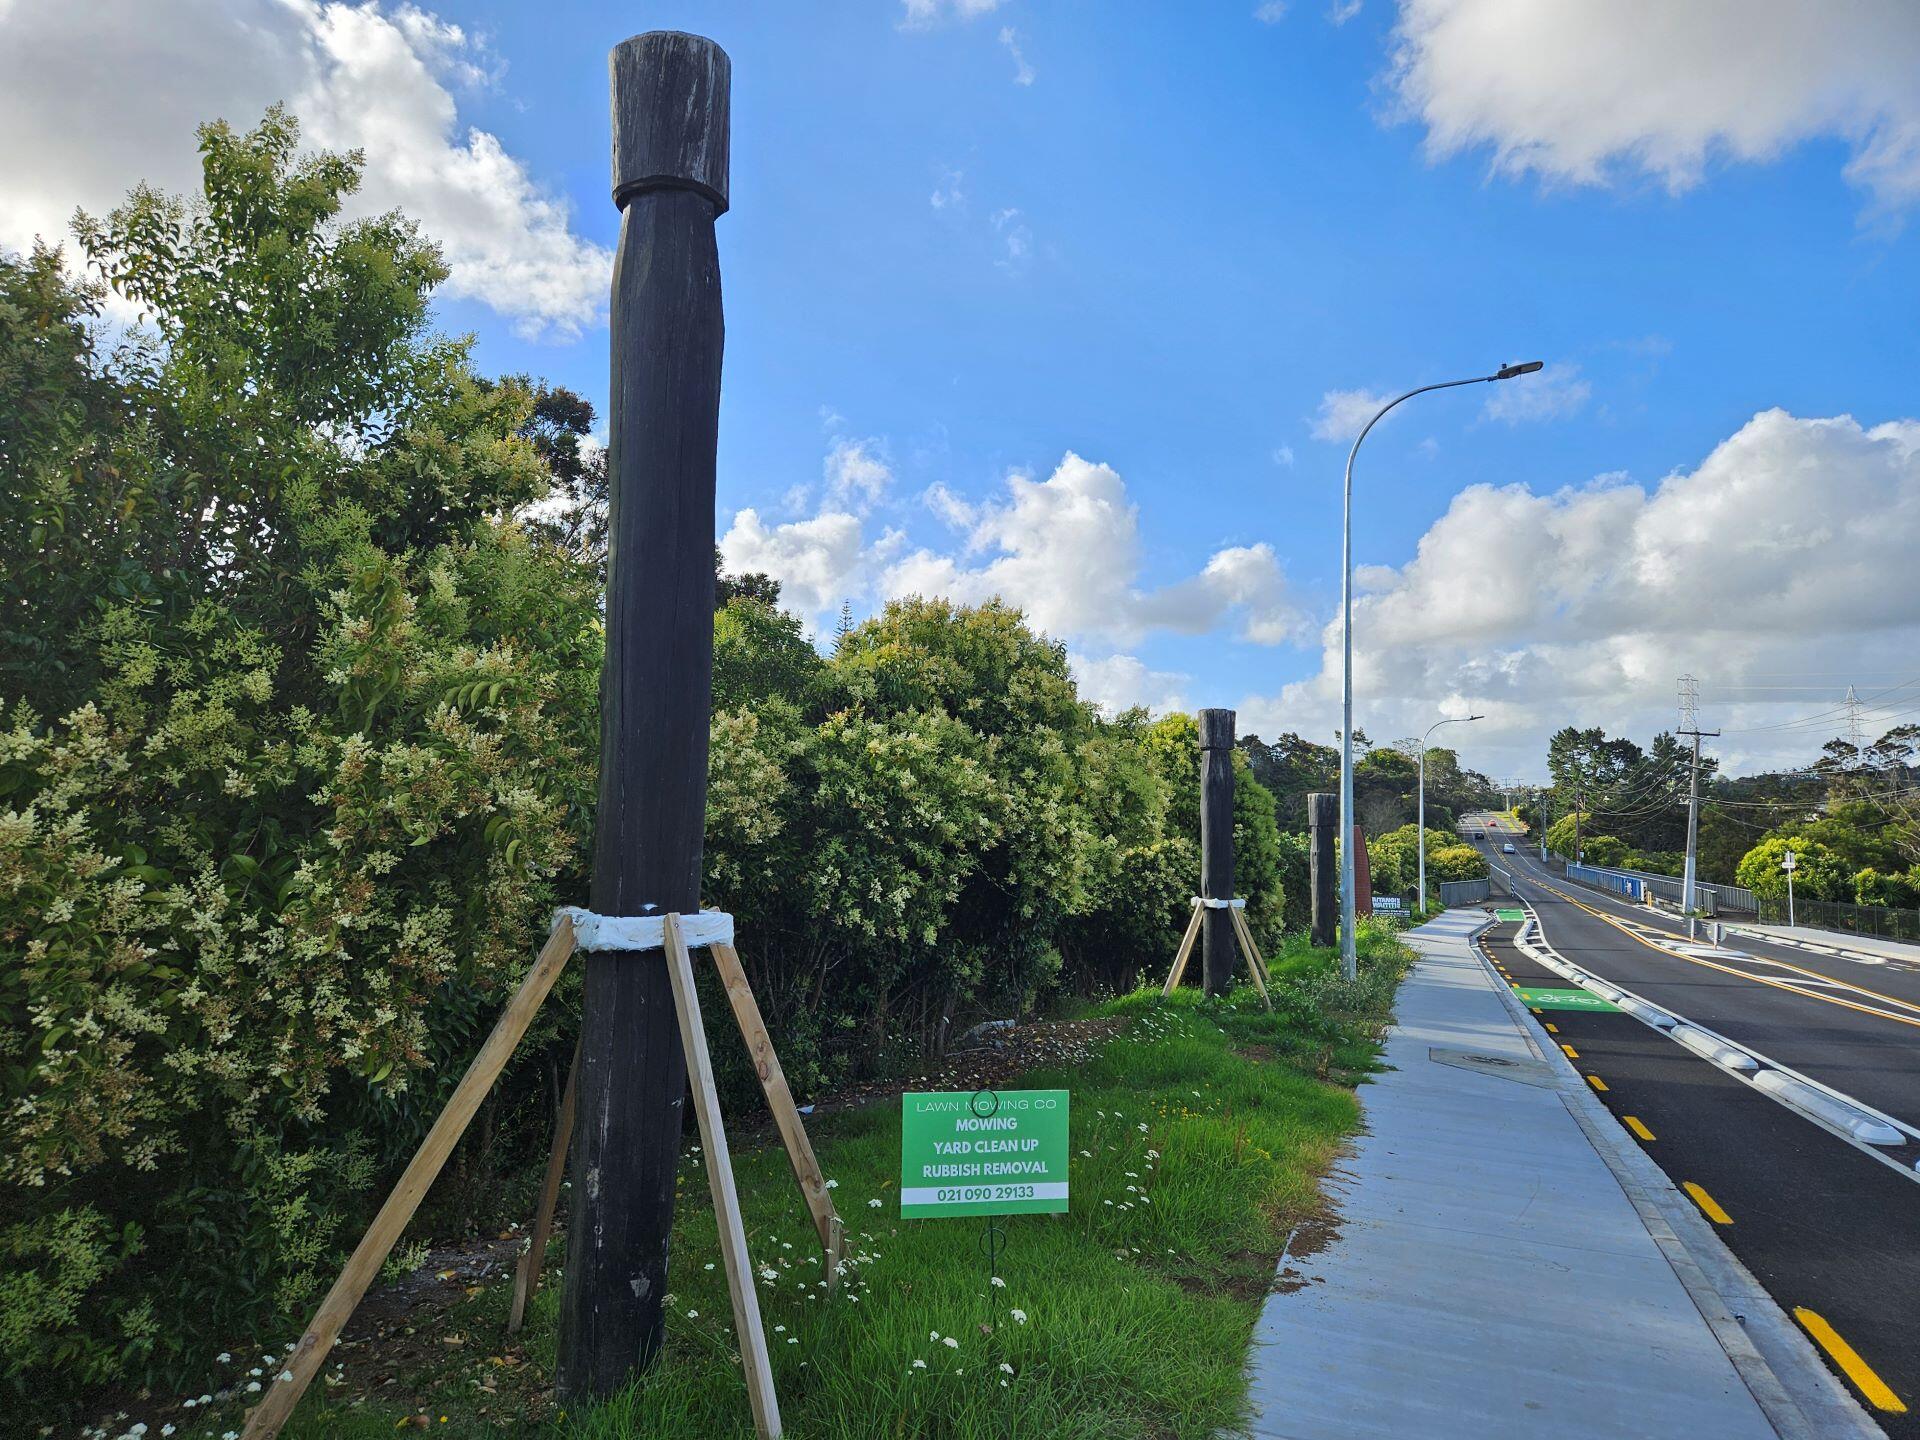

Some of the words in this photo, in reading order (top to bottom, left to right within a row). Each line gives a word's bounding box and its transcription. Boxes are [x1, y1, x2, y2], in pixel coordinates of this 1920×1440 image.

[916, 1102, 959, 1112] LAWN
[965, 1100, 1029, 1111] MOWING
[1034, 1099, 1056, 1109] CO
[956, 1118, 1017, 1131] MOWING
[933, 1141, 971, 1155] YARD
[974, 1140, 1018, 1153] CLEAN
[1021, 1139, 1039, 1151] UP
[923, 1164, 980, 1177] RUBBISH
[983, 1161, 1048, 1175] REMOVAL
[937, 1189, 961, 1201] 021
[965, 1188, 991, 1200] 090
[995, 1186, 1034, 1199] 29133
